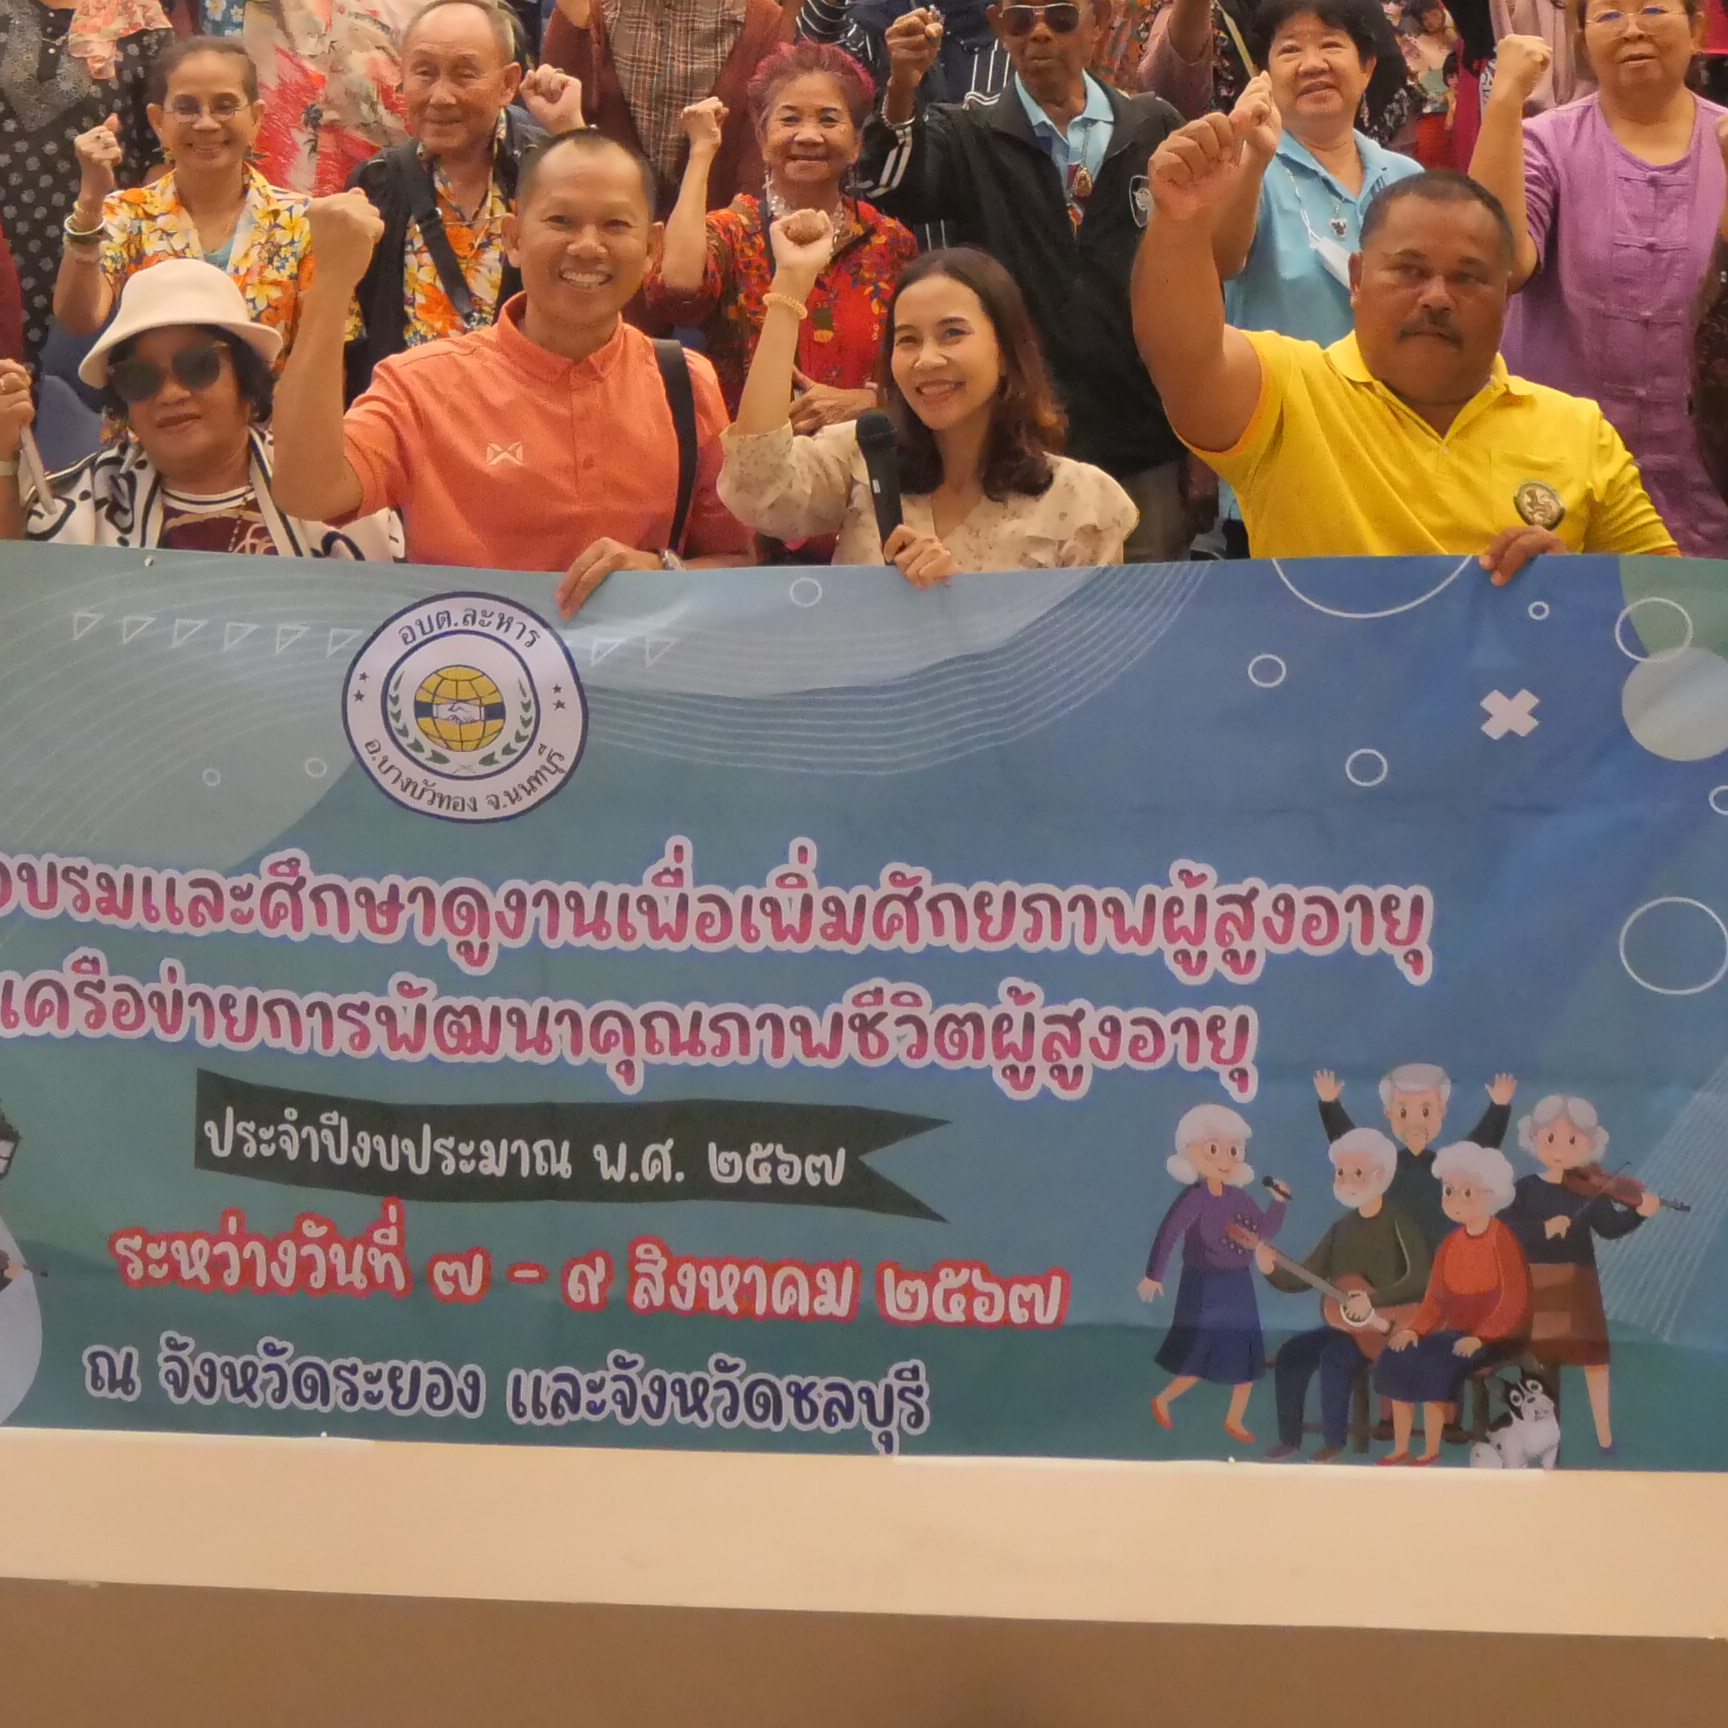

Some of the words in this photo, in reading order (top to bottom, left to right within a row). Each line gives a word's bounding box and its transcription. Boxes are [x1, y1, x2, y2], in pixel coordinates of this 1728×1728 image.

[398, 607, 542, 649] อบต.ละหาร
[204, 1105, 572, 1181] ประจำปีงบประมาณ
[592, 1137, 686, 1184] พ.ศ.
[707, 1139, 846, 1188] ๒๕๖๗
[114, 1203, 407, 1292] ระหว่างวันที่
[430, 1252, 485, 1298] ๗
[630, 1240, 855, 1318] สิงหาคม
[881, 1265, 1063, 1326] ๒๕๖๗
[84, 1345, 138, 1398] ณ
[160, 1334, 485, 1416] จังหวัดระยอง
[509, 1352, 930, 1455] และจังหวัดชลบุรี
